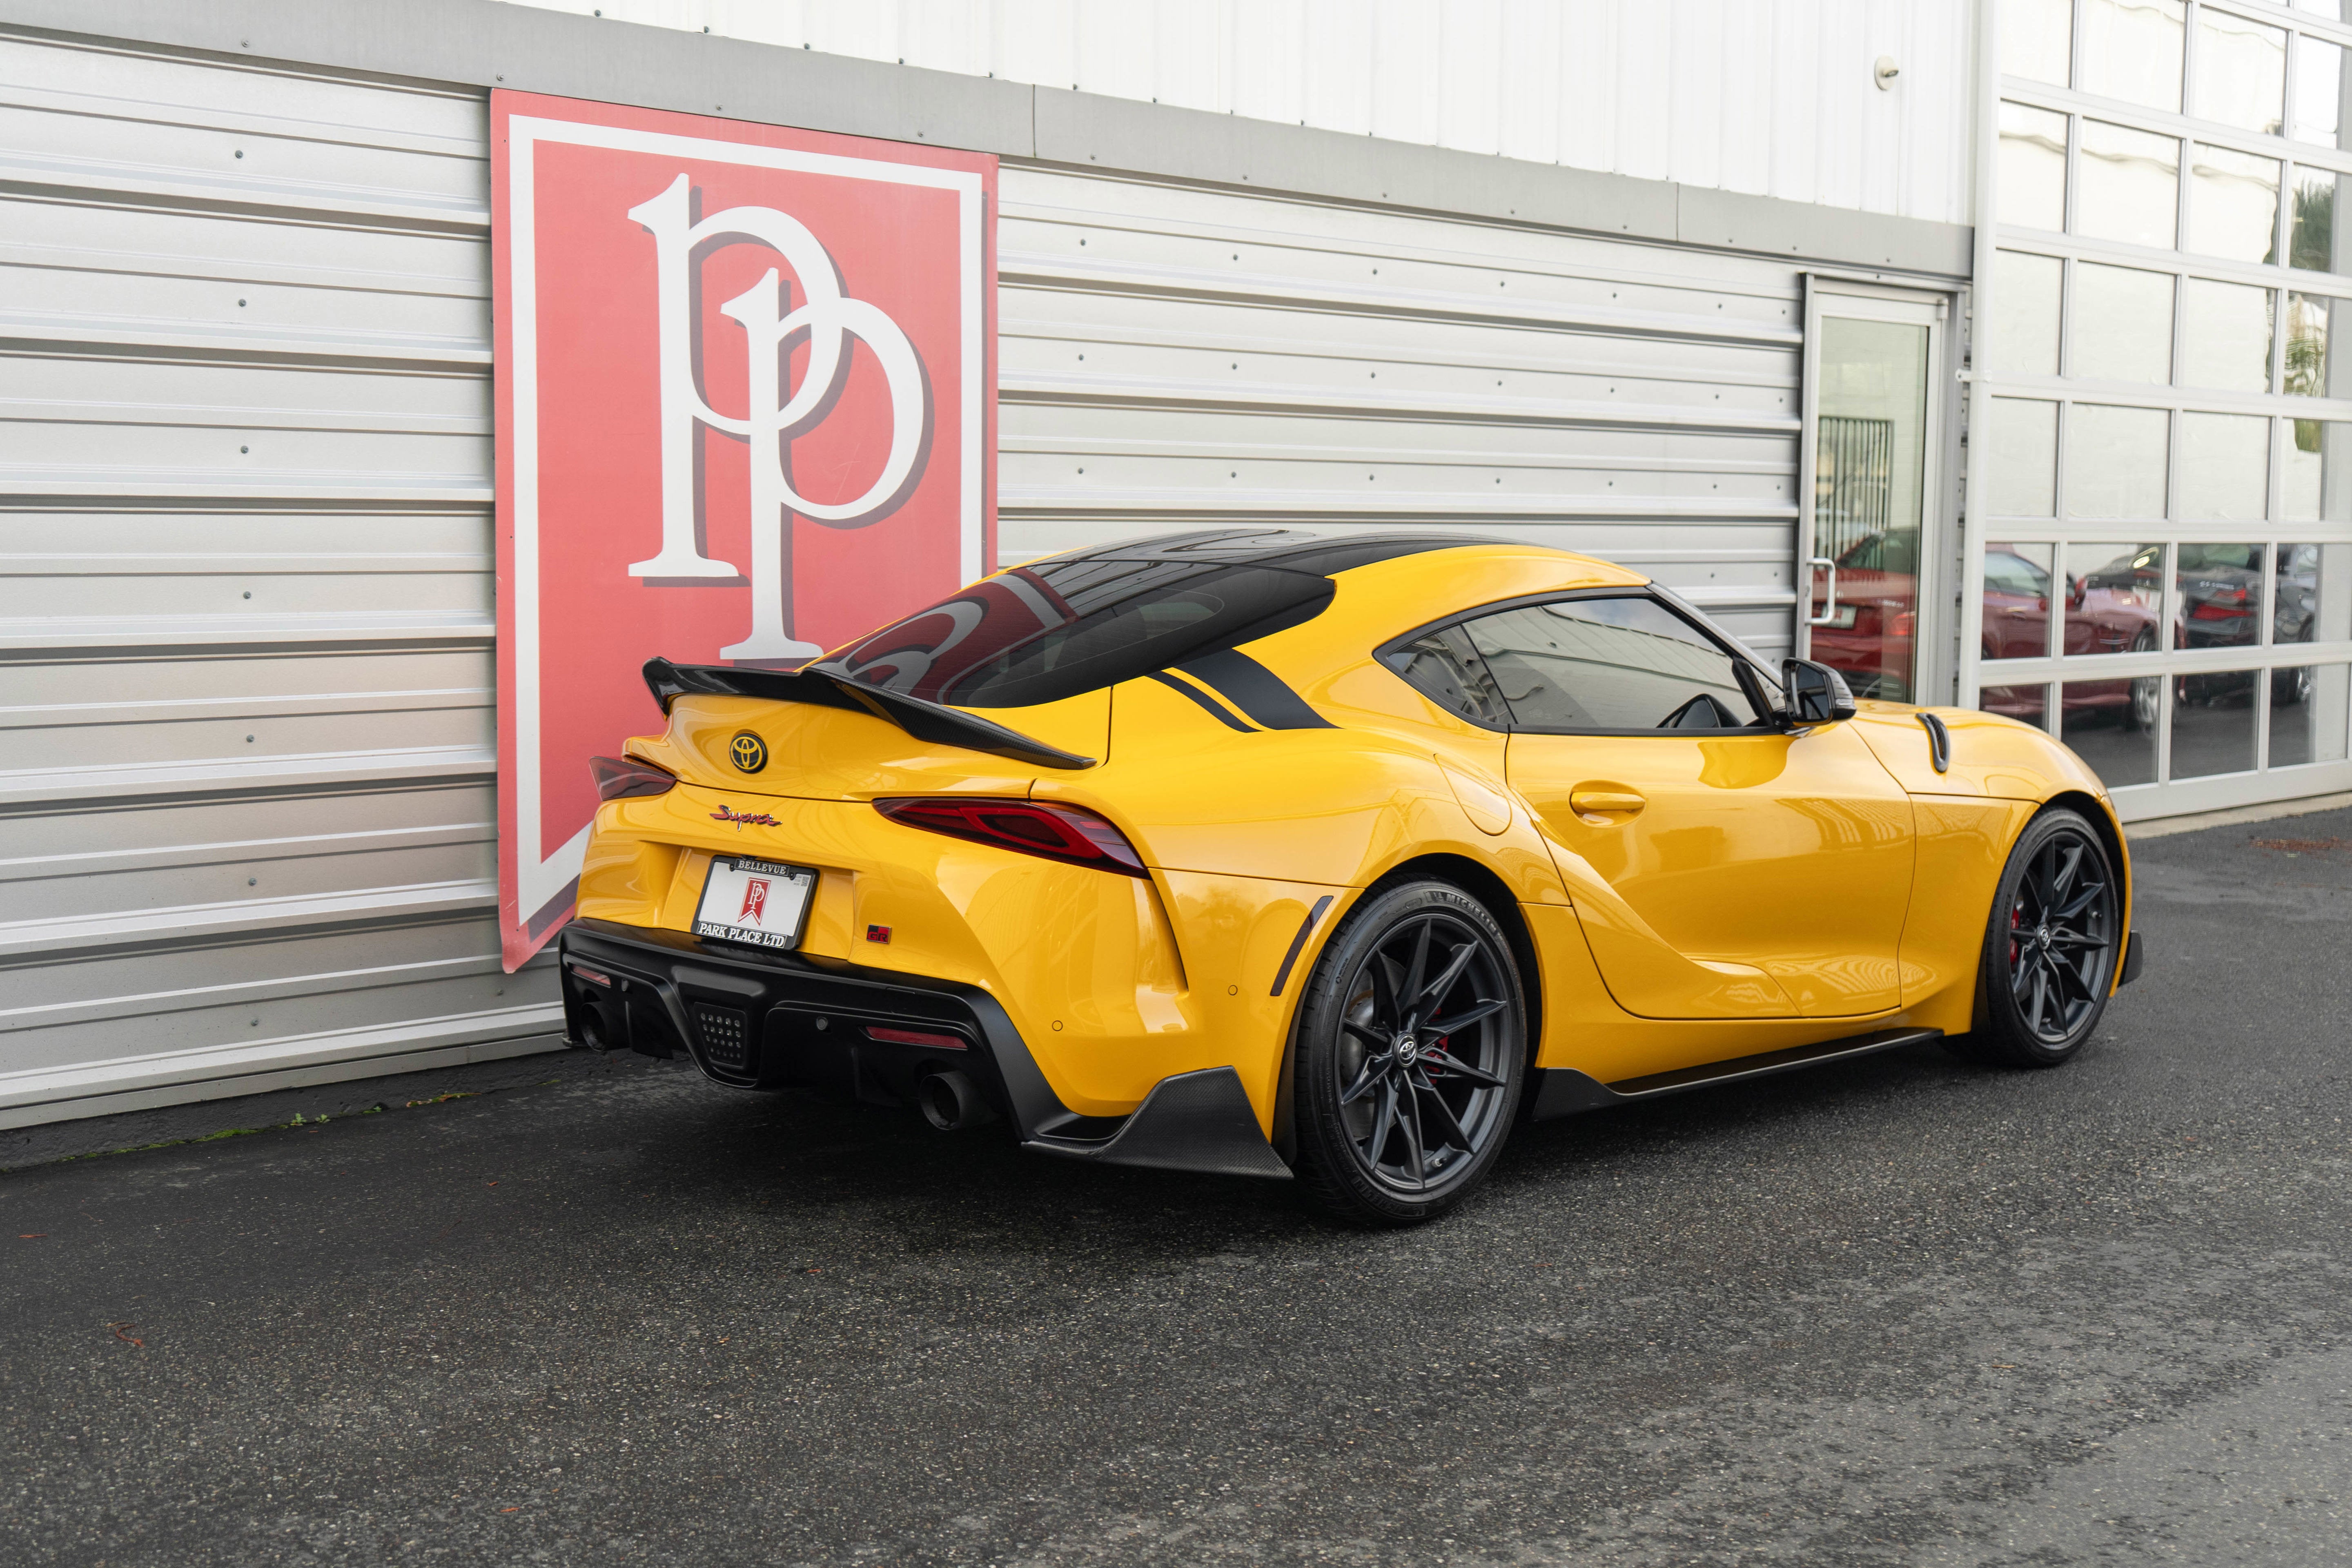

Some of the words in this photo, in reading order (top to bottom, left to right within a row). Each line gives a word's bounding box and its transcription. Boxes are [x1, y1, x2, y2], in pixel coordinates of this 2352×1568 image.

[709, 804, 783, 832] Supra
[738, 860, 786, 874] BELLEVUE
[1446, 893, 1497, 933] MICHELIN
[698, 922, 728, 938] PARK
[728, 928, 762, 943] PLACE
[763, 933, 785, 947] LTD
[868, 931, 888, 942] GR
